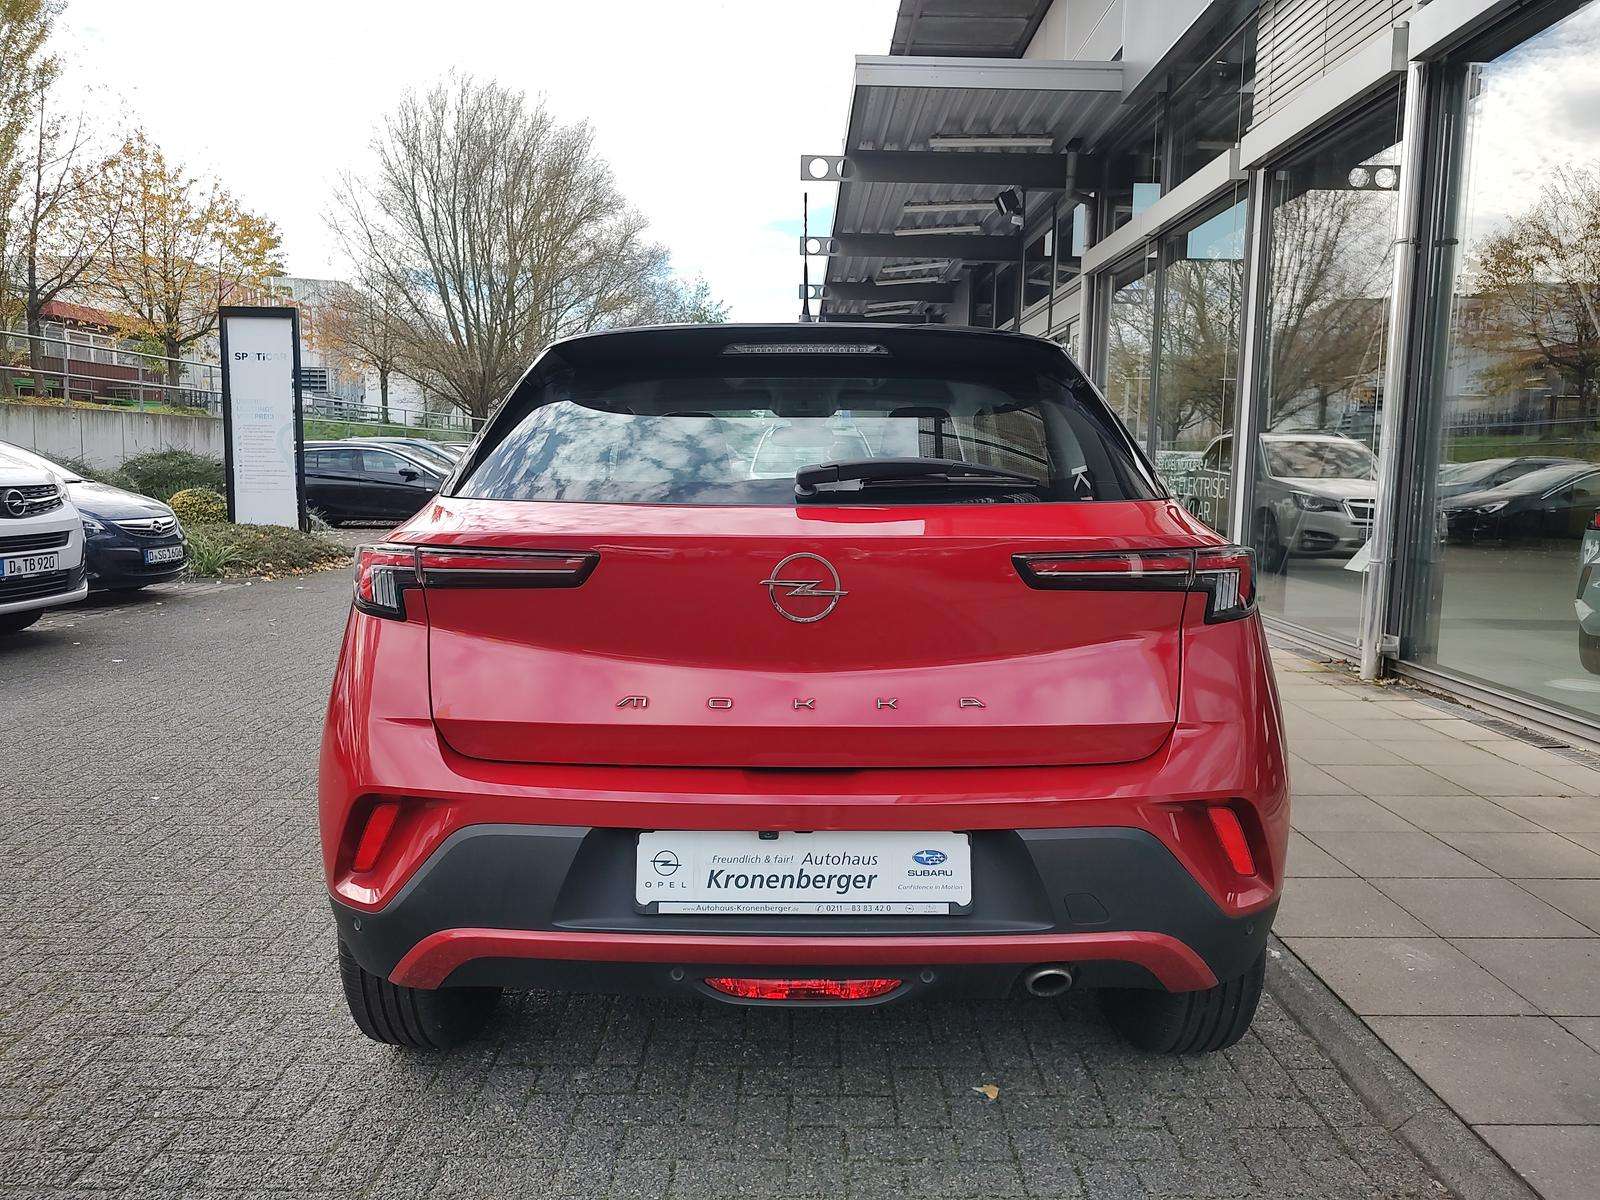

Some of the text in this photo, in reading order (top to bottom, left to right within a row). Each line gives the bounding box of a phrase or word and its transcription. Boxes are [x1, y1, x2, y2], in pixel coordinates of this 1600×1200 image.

[9, 556, 55, 574] D TB 920
[616, 695, 986, 709] MOKKA
[712, 854, 794, 864] Freundlich & fair!
[801, 852, 878, 866] Autohaus
[907, 869, 953, 877] SUBARU
[707, 869, 878, 895] Kronenberger
[682, 904, 800, 913] www.Autohaus-Kronenberger.de
